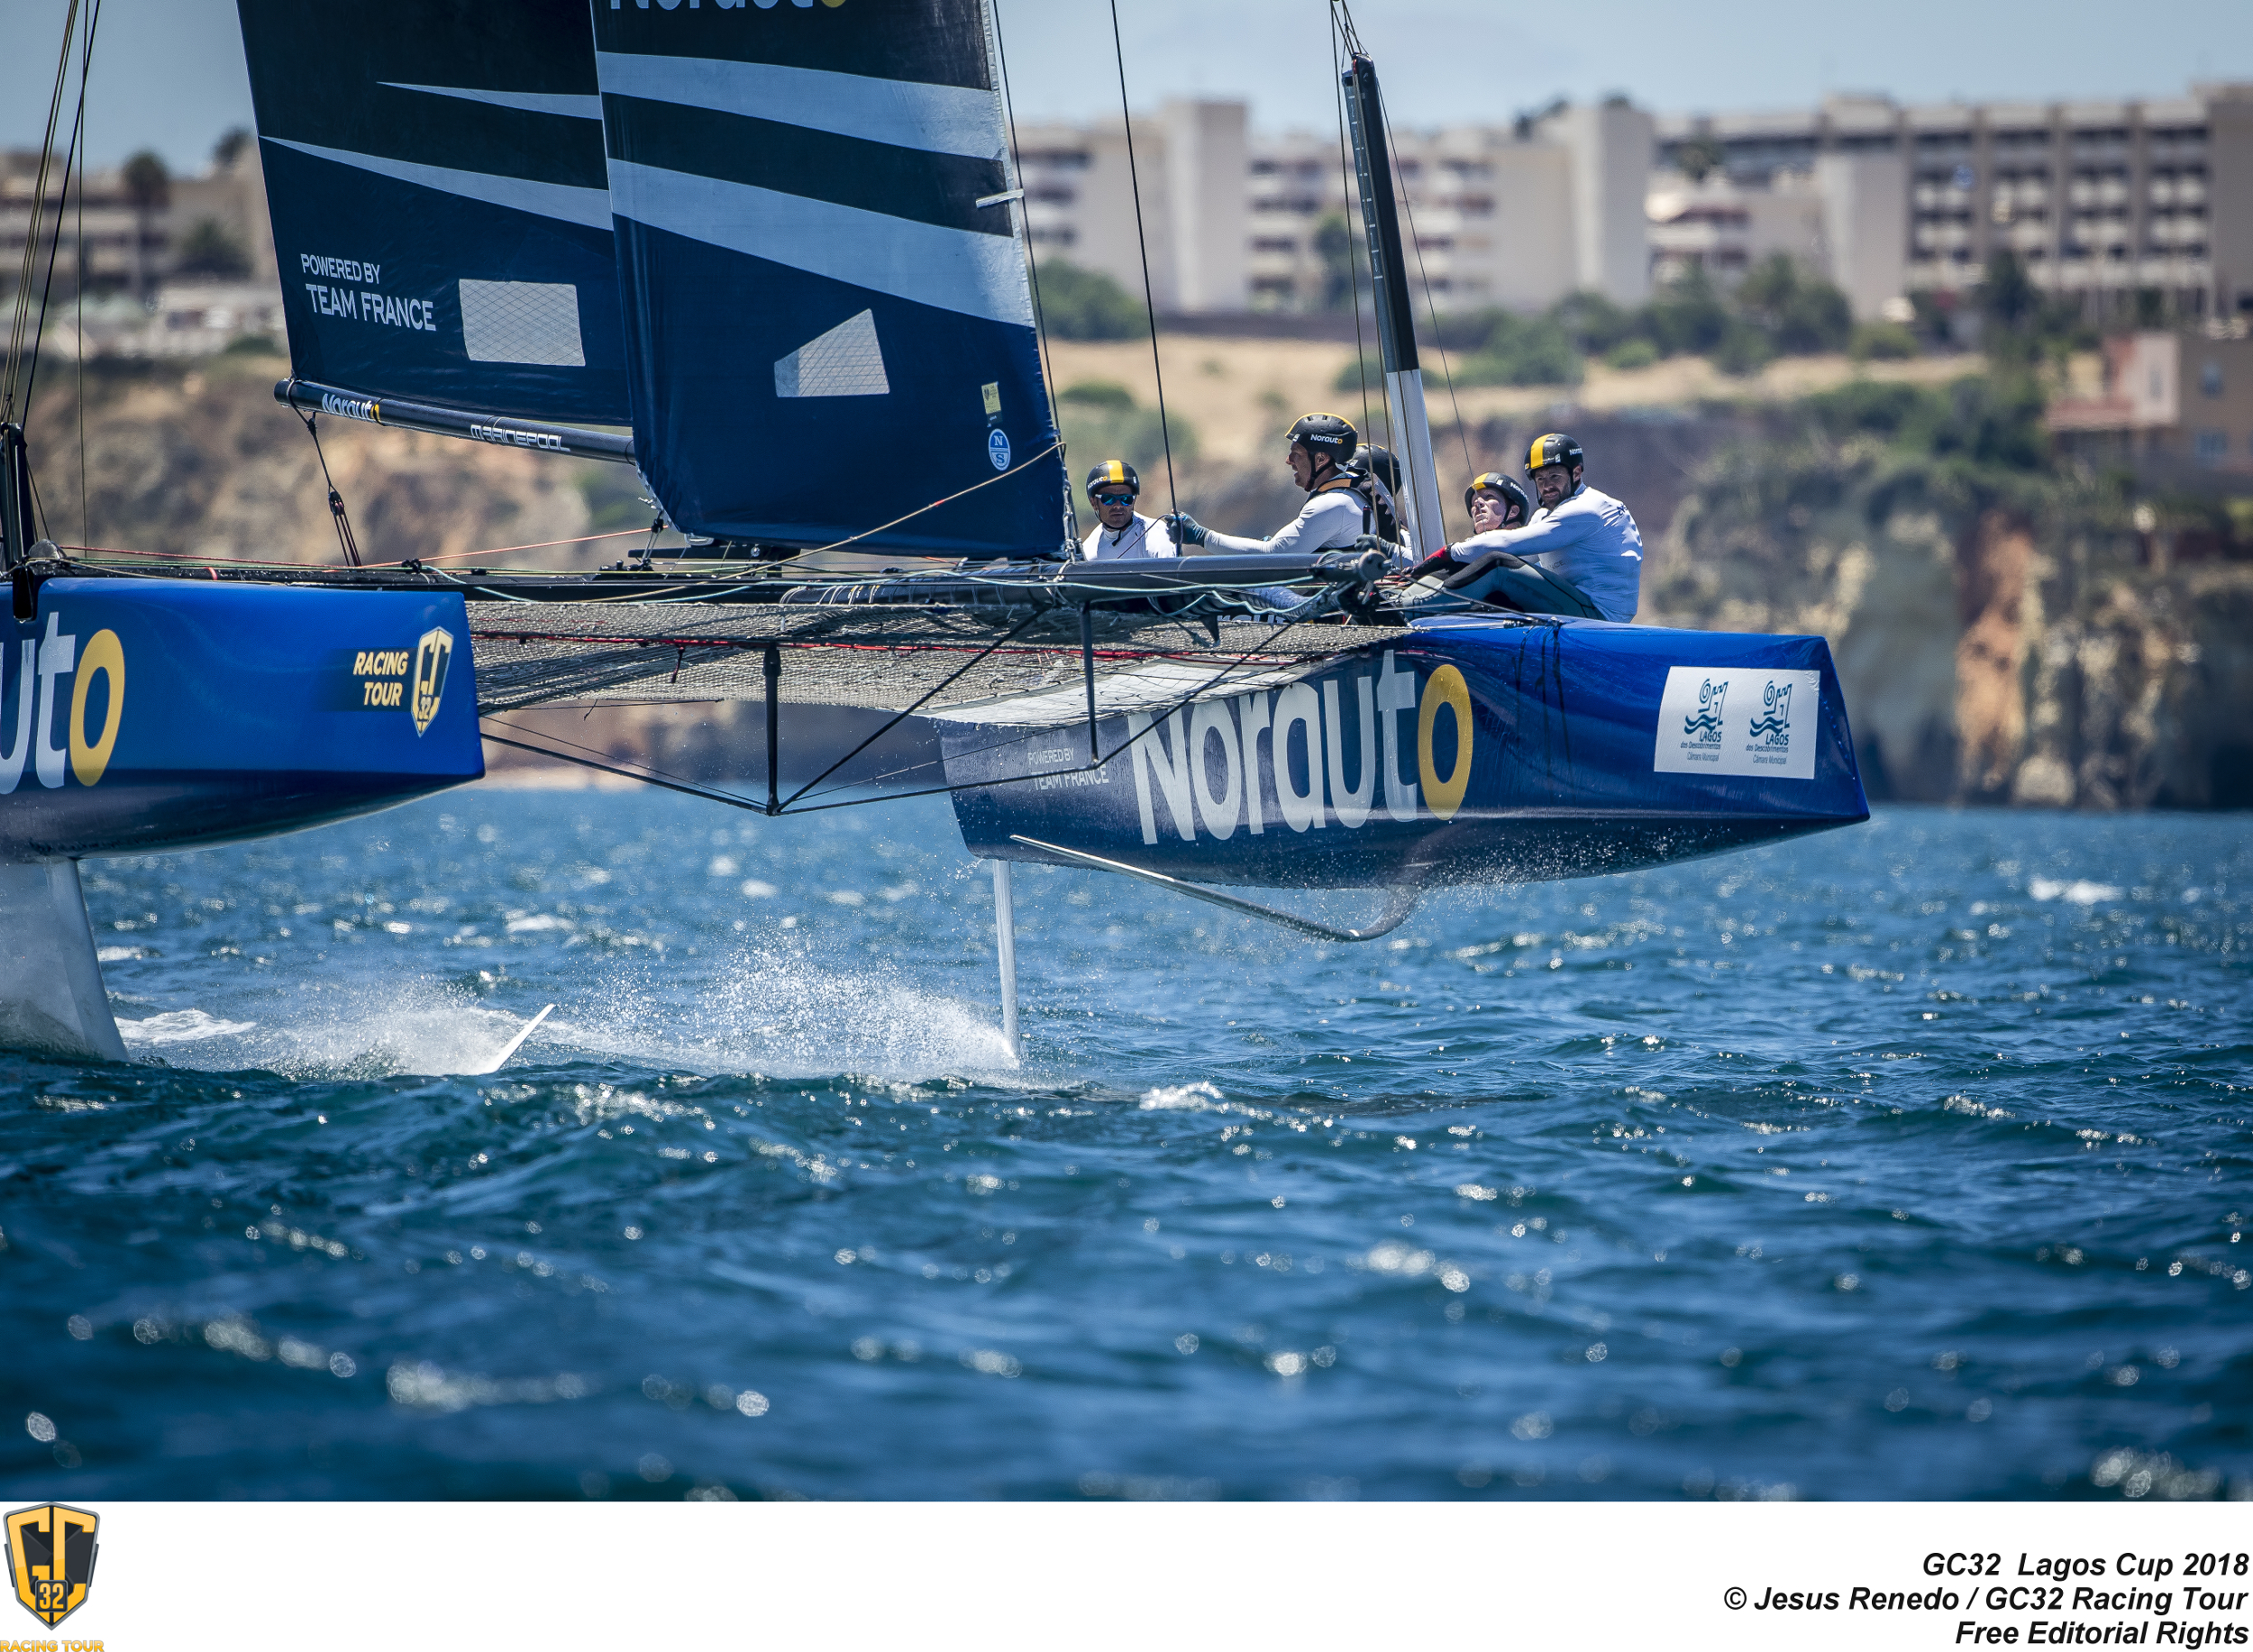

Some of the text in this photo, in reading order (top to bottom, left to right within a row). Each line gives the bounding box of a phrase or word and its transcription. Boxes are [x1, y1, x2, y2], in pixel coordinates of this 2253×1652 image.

[300, 253, 380, 285] POWERED BY
[305, 283, 437, 332] TEAM FRANCE
[322, 393, 380, 421] Norauto
[1309, 434, 1343, 444] Norauto
[352, 651, 409, 676] RACING
[0, 611, 125, 795] uto
[363, 681, 403, 707] TOUR
[419, 696, 432, 720] 32
[1127, 650, 1473, 844] Norauto
[1699, 731, 1722, 743] LAGOS
[1765, 734, 1790, 746] LAGOS
[1027, 747, 1074, 765] POWERED BY
[1031, 763, 1109, 790] TEAM FRANCE
